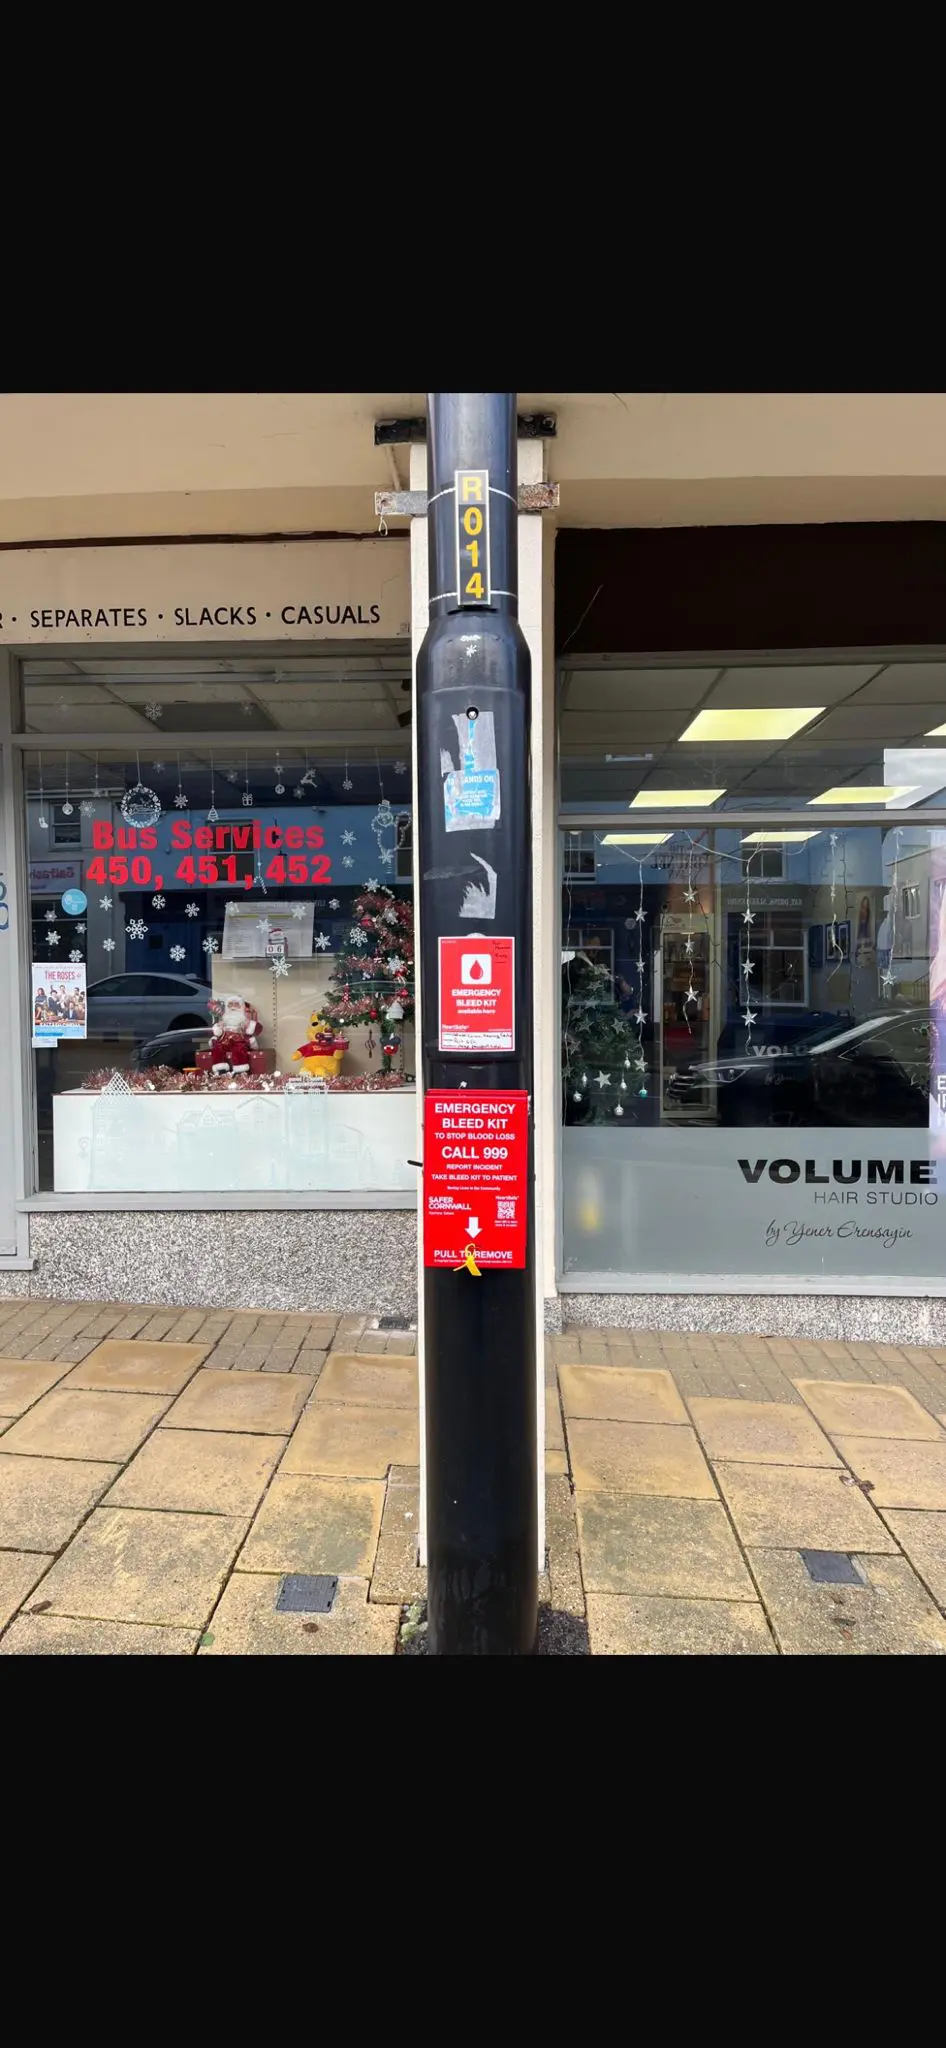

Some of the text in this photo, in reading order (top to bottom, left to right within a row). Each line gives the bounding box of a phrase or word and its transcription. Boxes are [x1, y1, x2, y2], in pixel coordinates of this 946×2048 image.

[462, 475, 485, 600] R014
[30, 604, 381, 628] SEPARATES SLACKS CASUALS
[92, 819, 325, 850] Bus Services
[86, 855, 332, 890] 450, 451, 452
[44, 970, 76, 980] THE ROSES
[451, 988, 502, 997] EMERGENCY
[434, 1103, 516, 1114] EMERGENCY
[442, 1118, 508, 1129] BLEED KIT
[441, 1146, 508, 1159] CALL 999
[737, 1159, 938, 1185] VOLUME
[814, 1191, 938, 1206] HAIR STUDIO
[765, 1218, 782, 1246] by
[434, 1250, 457, 1258] PULL
[474, 1250, 512, 1259] REMOVE
